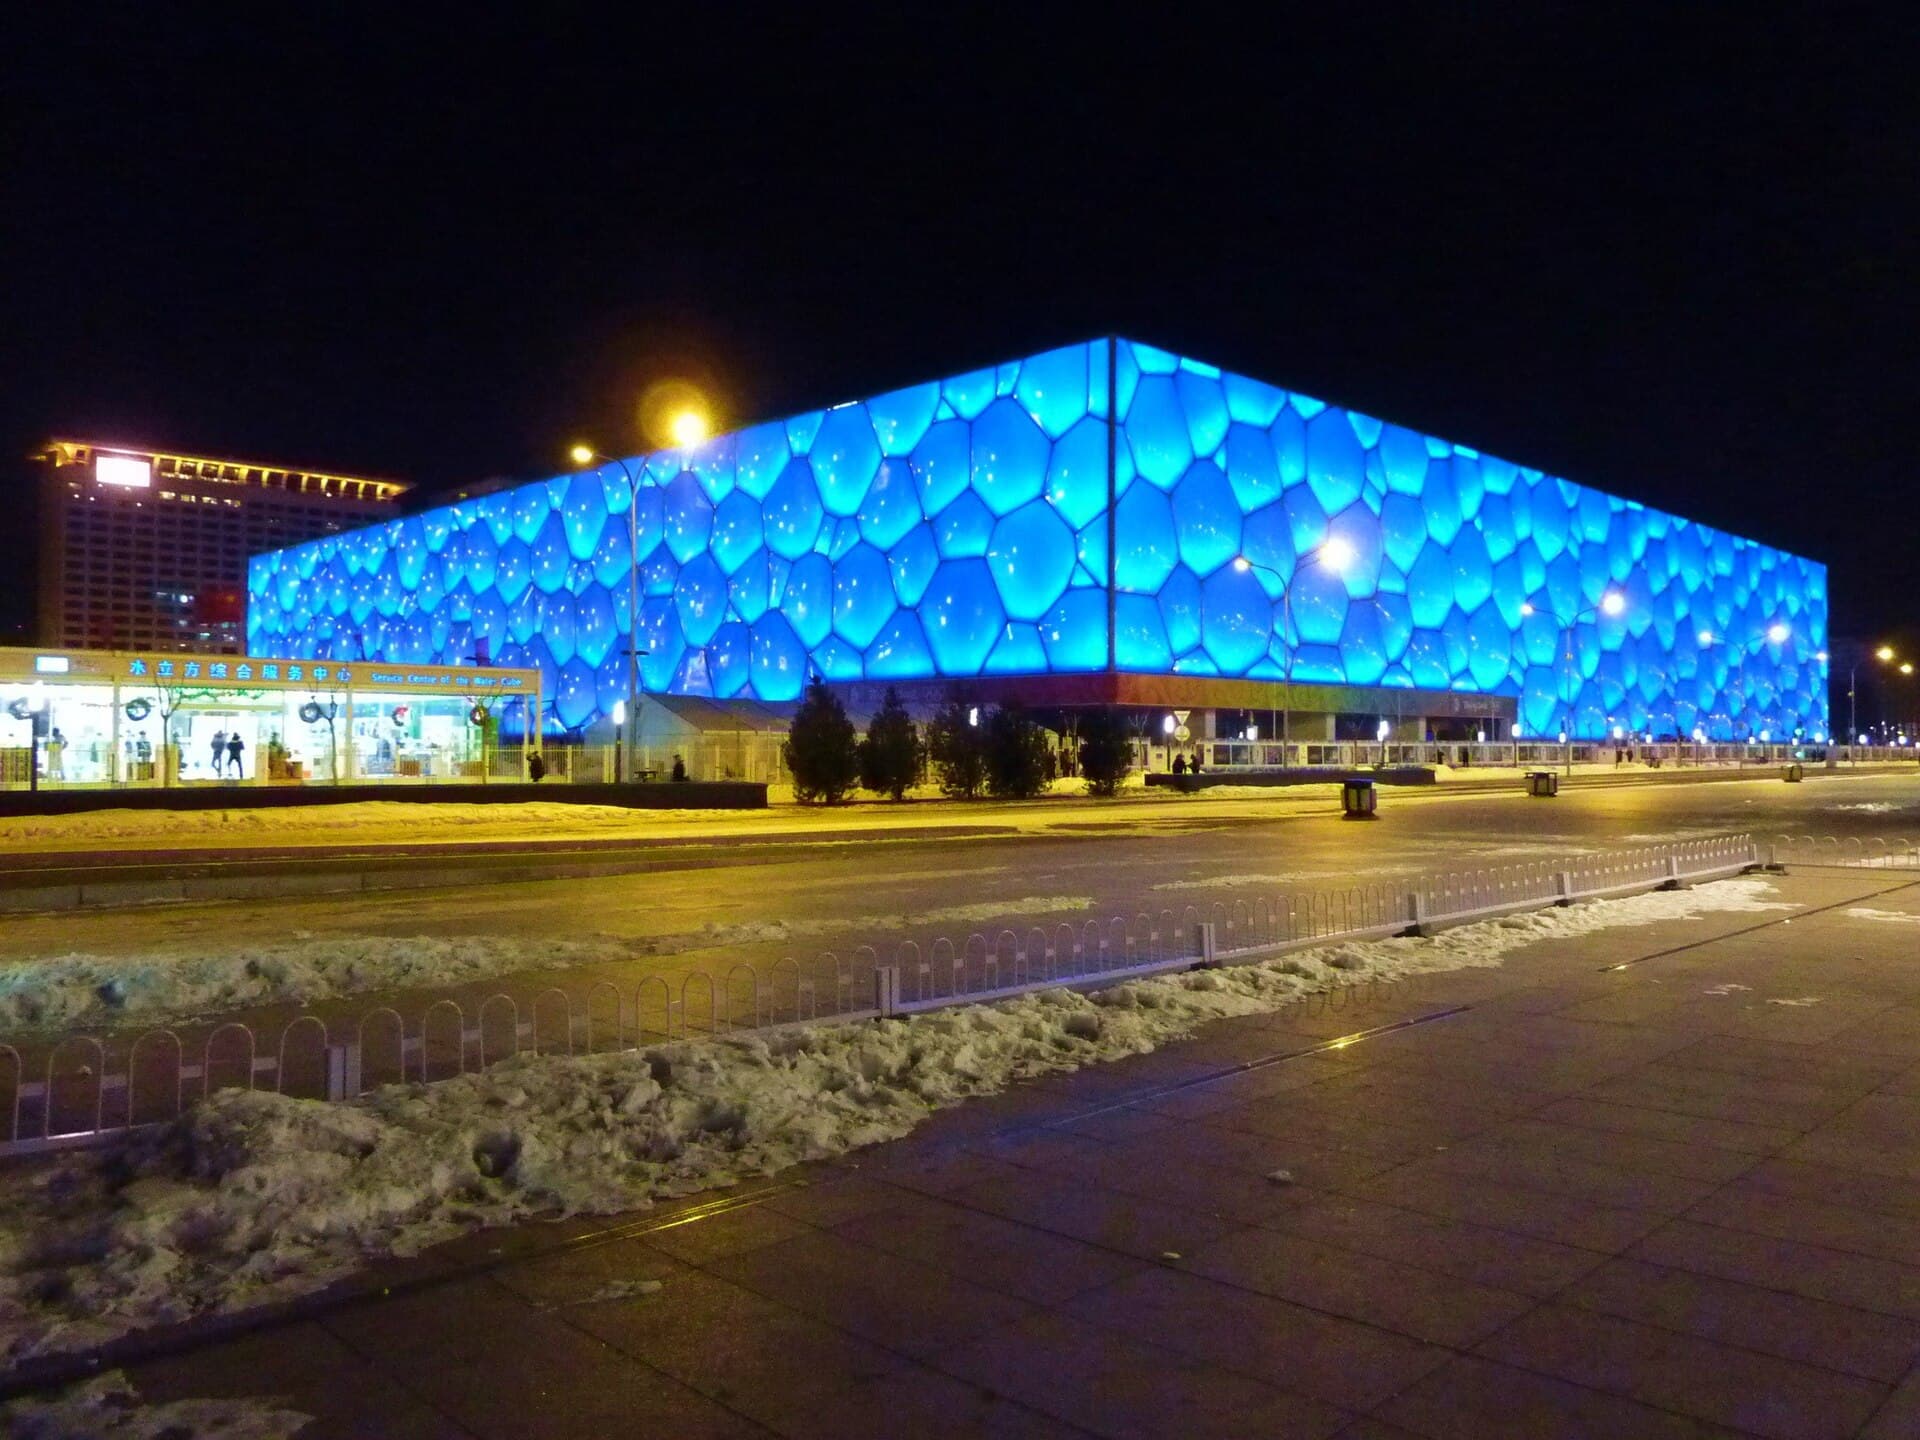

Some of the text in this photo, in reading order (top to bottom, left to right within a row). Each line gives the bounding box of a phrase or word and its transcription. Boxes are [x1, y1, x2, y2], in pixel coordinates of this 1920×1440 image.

[130, 659, 351, 681] 水立方综合服务中心
[371, 673, 403, 683] Service
[440, 676, 450, 685] of
[456, 677, 469, 686] the
[501, 677, 522, 687] Cube
